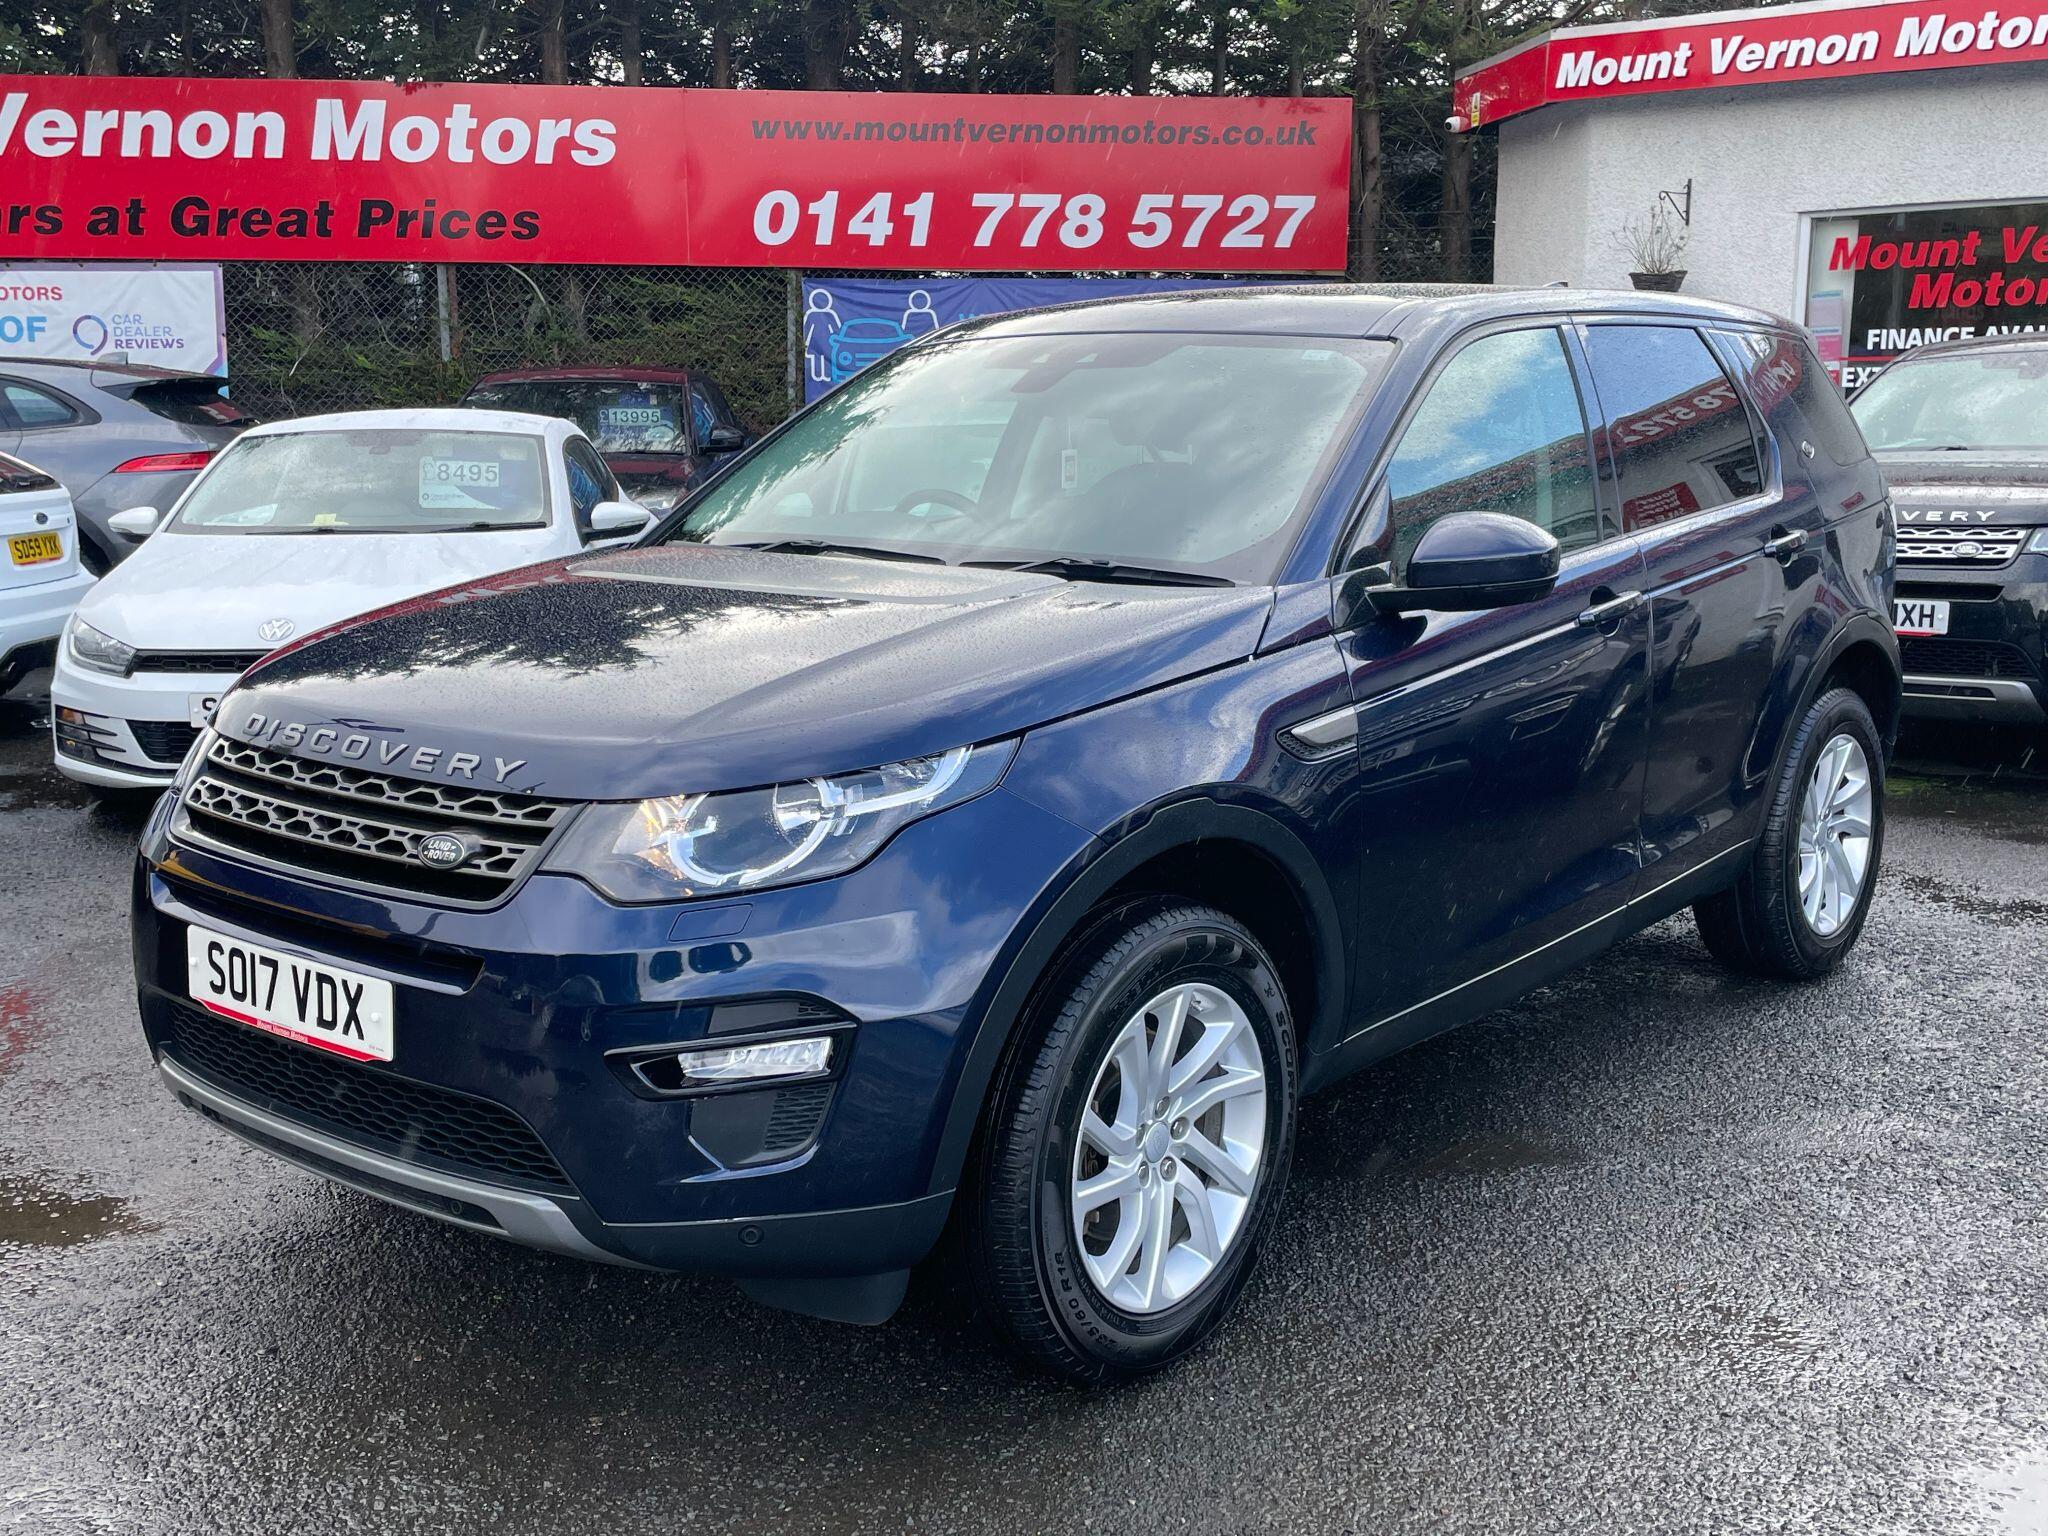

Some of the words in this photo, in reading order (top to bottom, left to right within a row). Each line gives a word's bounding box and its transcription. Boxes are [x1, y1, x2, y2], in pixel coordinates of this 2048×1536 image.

[1555, 42, 1693, 89] Mount
[1710, 30, 1879, 76] Vernon
[310, 98, 618, 166] Motors
[752, 118, 1318, 146] www.mountvernonmotors.co.uk
[0, 203, 63, 236] rs
[86, 198, 146, 236] at
[170, 196, 335, 239] Great
[356, 198, 541, 241] Prices
[752, 189, 935, 247] 0141
[971, 192, 1106, 249] 778
[1127, 193, 1316, 249] 5727
[1828, 230, 1982, 271] Mount
[0, 315, 48, 343] OF
[112, 314, 143, 325] CAR
[113, 326, 173, 337] DEALER
[115, 338, 185, 349] REVIEWS
[243, 713, 527, 783] DISCOVERY
[428, 840, 451, 850] LAND
[428, 849, 456, 861] ROVER
[208, 941, 279, 1012] SO17
[291, 964, 365, 1040] VDX
